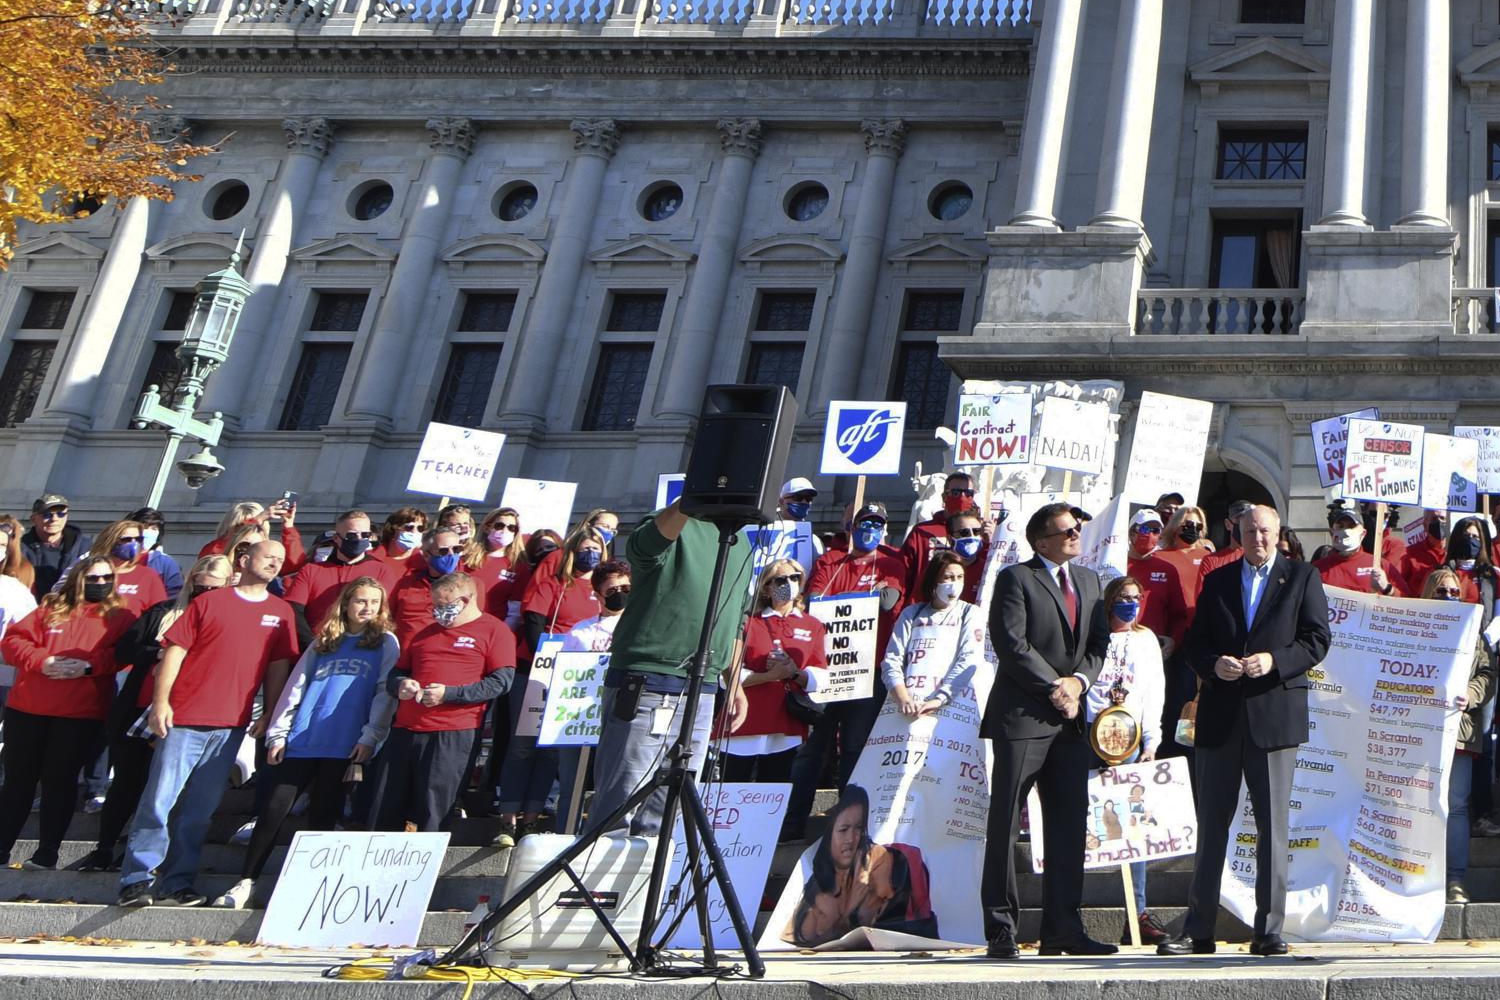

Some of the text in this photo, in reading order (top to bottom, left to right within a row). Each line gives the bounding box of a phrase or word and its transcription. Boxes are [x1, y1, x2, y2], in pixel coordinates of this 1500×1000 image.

[961, 403, 991, 417] FAIR
[838, 408, 901, 458] aft
[960, 419, 1016, 436] Contract
[959, 435, 1027, 461] NOW!
[1042, 437, 1098, 463] NADA!
[1364, 438, 1411, 455] CENSOR
[1352, 452, 1378, 463] THESE
[421, 459, 489, 480] TEACHER
[1347, 464, 1416, 497] FAIR FUNDING
[835, 605, 851, 618] NO
[1334, 597, 1358, 612] THE
[1386, 605, 1461, 622] time for our district
[1368, 622, 1386, 631] that
[1387, 625, 1404, 635] hurt
[1421, 628, 1438, 639] kids.
[1380, 615, 1398, 626] stop
[1399, 617, 1431, 630] making
[1432, 623, 1449, 631] cuts
[832, 637, 849, 650] NO
[911, 638, 936, 649] THE
[1348, 632, 1383, 645] Scranton
[1385, 638, 1416, 650] salaries
[1416, 642, 1428, 652] for
[1355, 643, 1393, 657] for school
[315, 658, 373, 678] WEST
[563, 669, 596, 682] OUR
[838, 669, 869, 677] FEDERATION
[1380, 658, 1439, 679] TODAY:
[559, 686, 587, 699] ARE
[1376, 680, 1435, 694] EDUCATORS
[1372, 690, 1450, 708] In Pennsylvania
[952, 711, 971, 724] and
[1369, 703, 1411, 717] $47,797
[1401, 720, 1434, 732] beginning
[933, 738, 943, 747] in
[1368, 729, 1423, 745] In Scranton
[1367, 744, 1407, 757] $38,377
[881, 751, 928, 767] 2017:
[920, 775, 942, 784] pre-K
[1101, 769, 1141, 787] Plus
[1365, 768, 1375, 778] In
[1377, 769, 1435, 790] Pennsylvania
[962, 785, 974, 793] NO
[1365, 782, 1402, 798] $71,500
[738, 789, 784, 815] Seeing
[958, 797, 971, 806] NO
[951, 819, 963, 827] NO
[1360, 805, 1412, 828] In Scranton
[946, 829, 986, 843] Elementary
[1356, 817, 1397, 840] $60,200
[284, 834, 432, 881] Fair Funding
[1097, 839, 1141, 862] much
[1235, 846, 1246, 856] In
[1349, 838, 1419, 873] SCHOOL STAFF
[1348, 850, 1403, 884] In Scranton
[298, 873, 408, 931] NOW!
[1333, 925, 1393, 938] average salary
